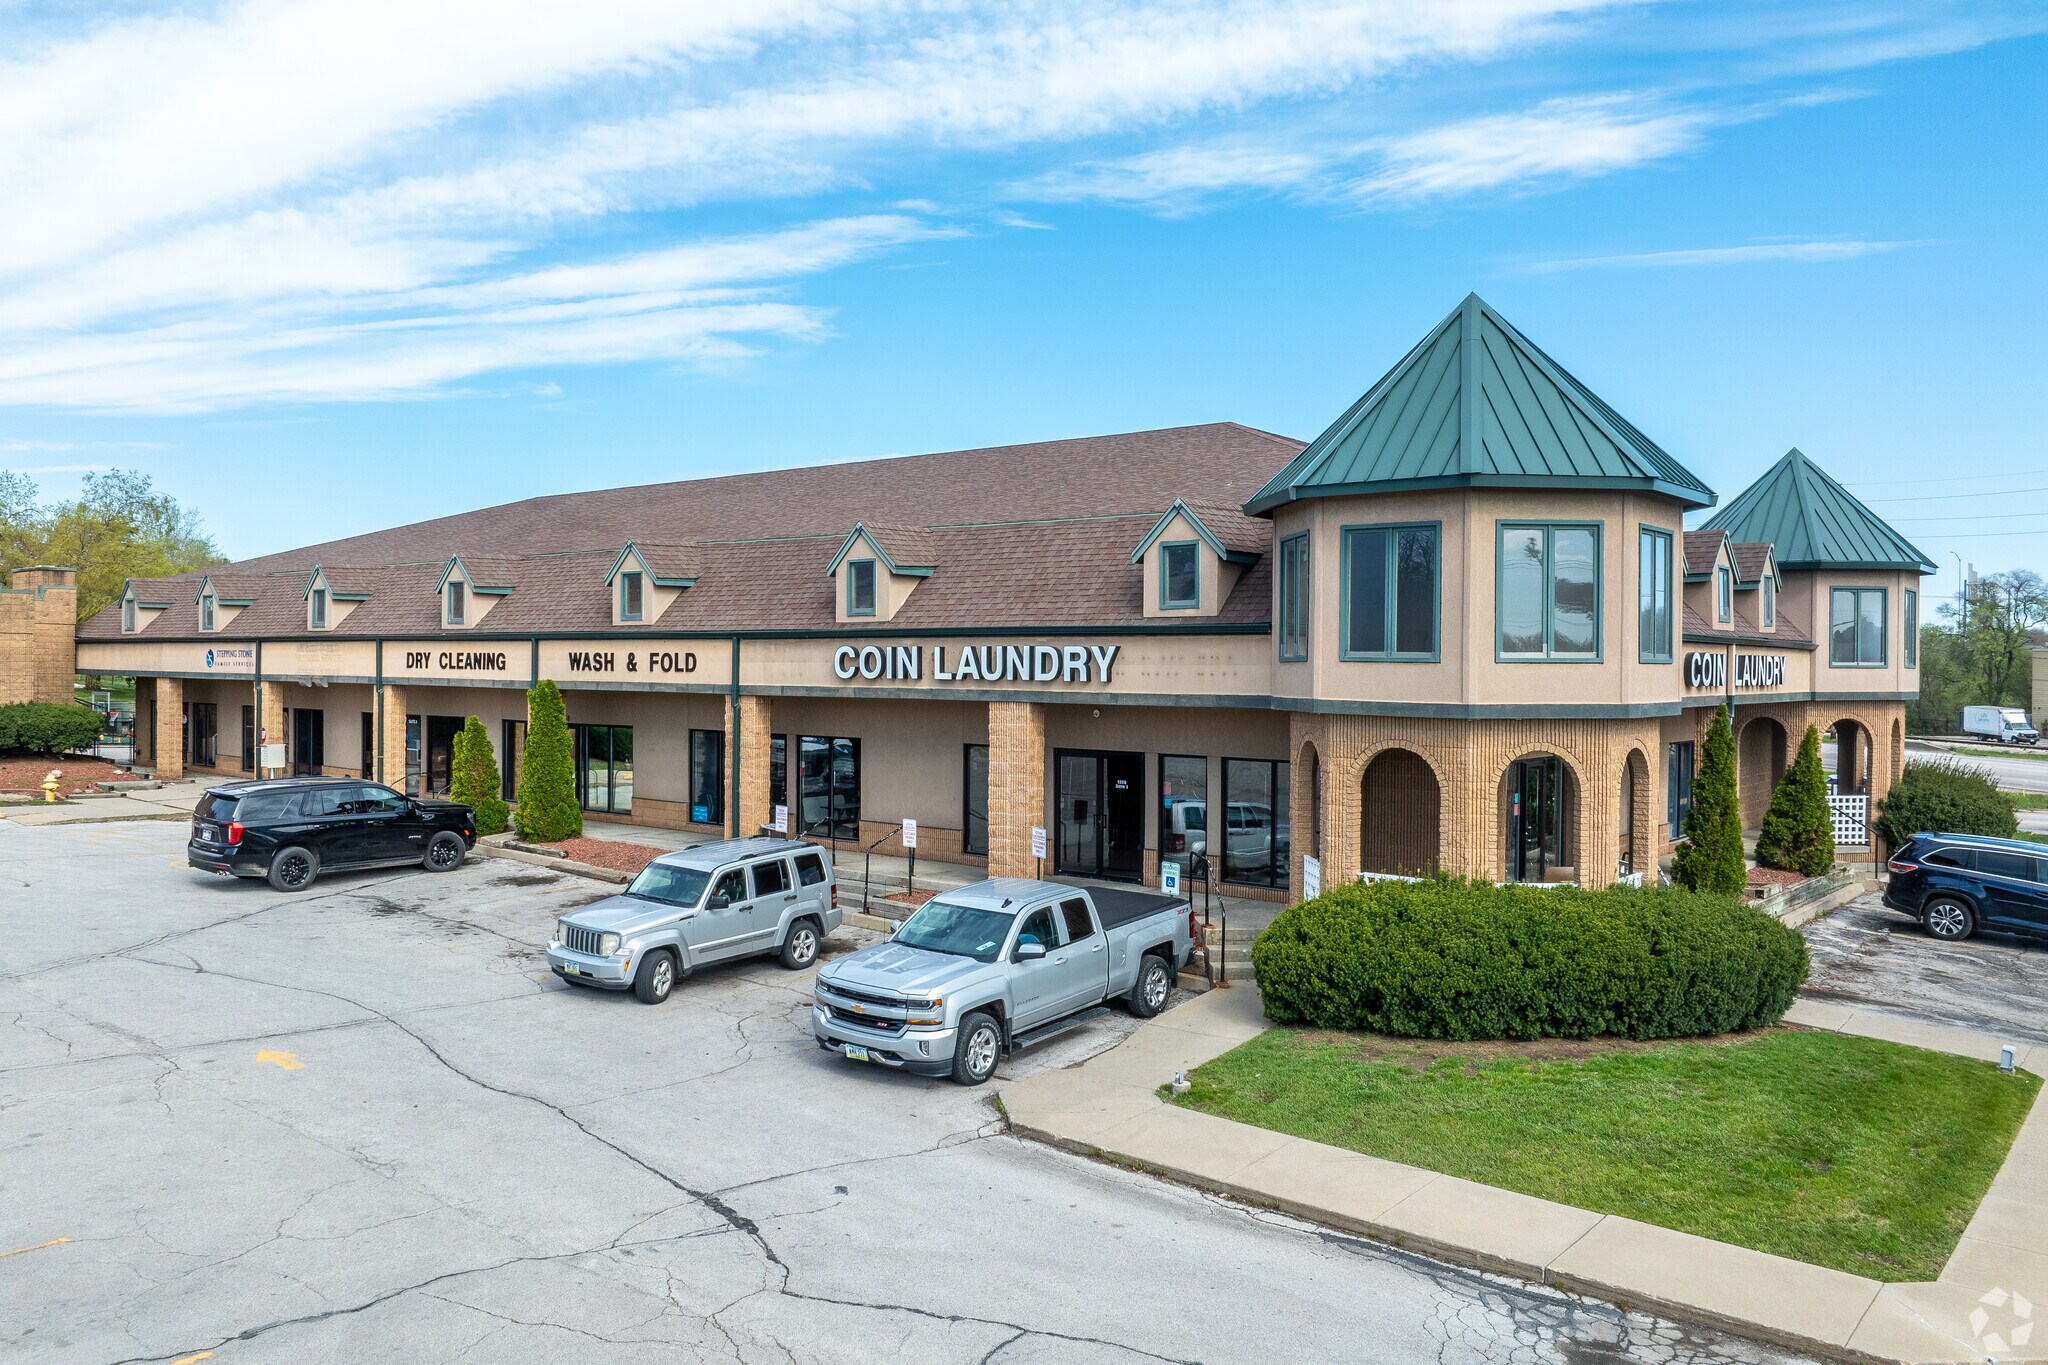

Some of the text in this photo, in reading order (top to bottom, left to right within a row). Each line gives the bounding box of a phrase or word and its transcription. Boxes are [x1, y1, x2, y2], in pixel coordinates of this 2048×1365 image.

[216, 649, 253, 658] STEPPING STONE
[406, 651, 507, 671] DRY CLEANING
[568, 652, 698, 674] WASH & FOLD
[834, 645, 1120, 683] COIN LAUNDRY
[1687, 652, 1787, 688] COIN LAUNDRY
